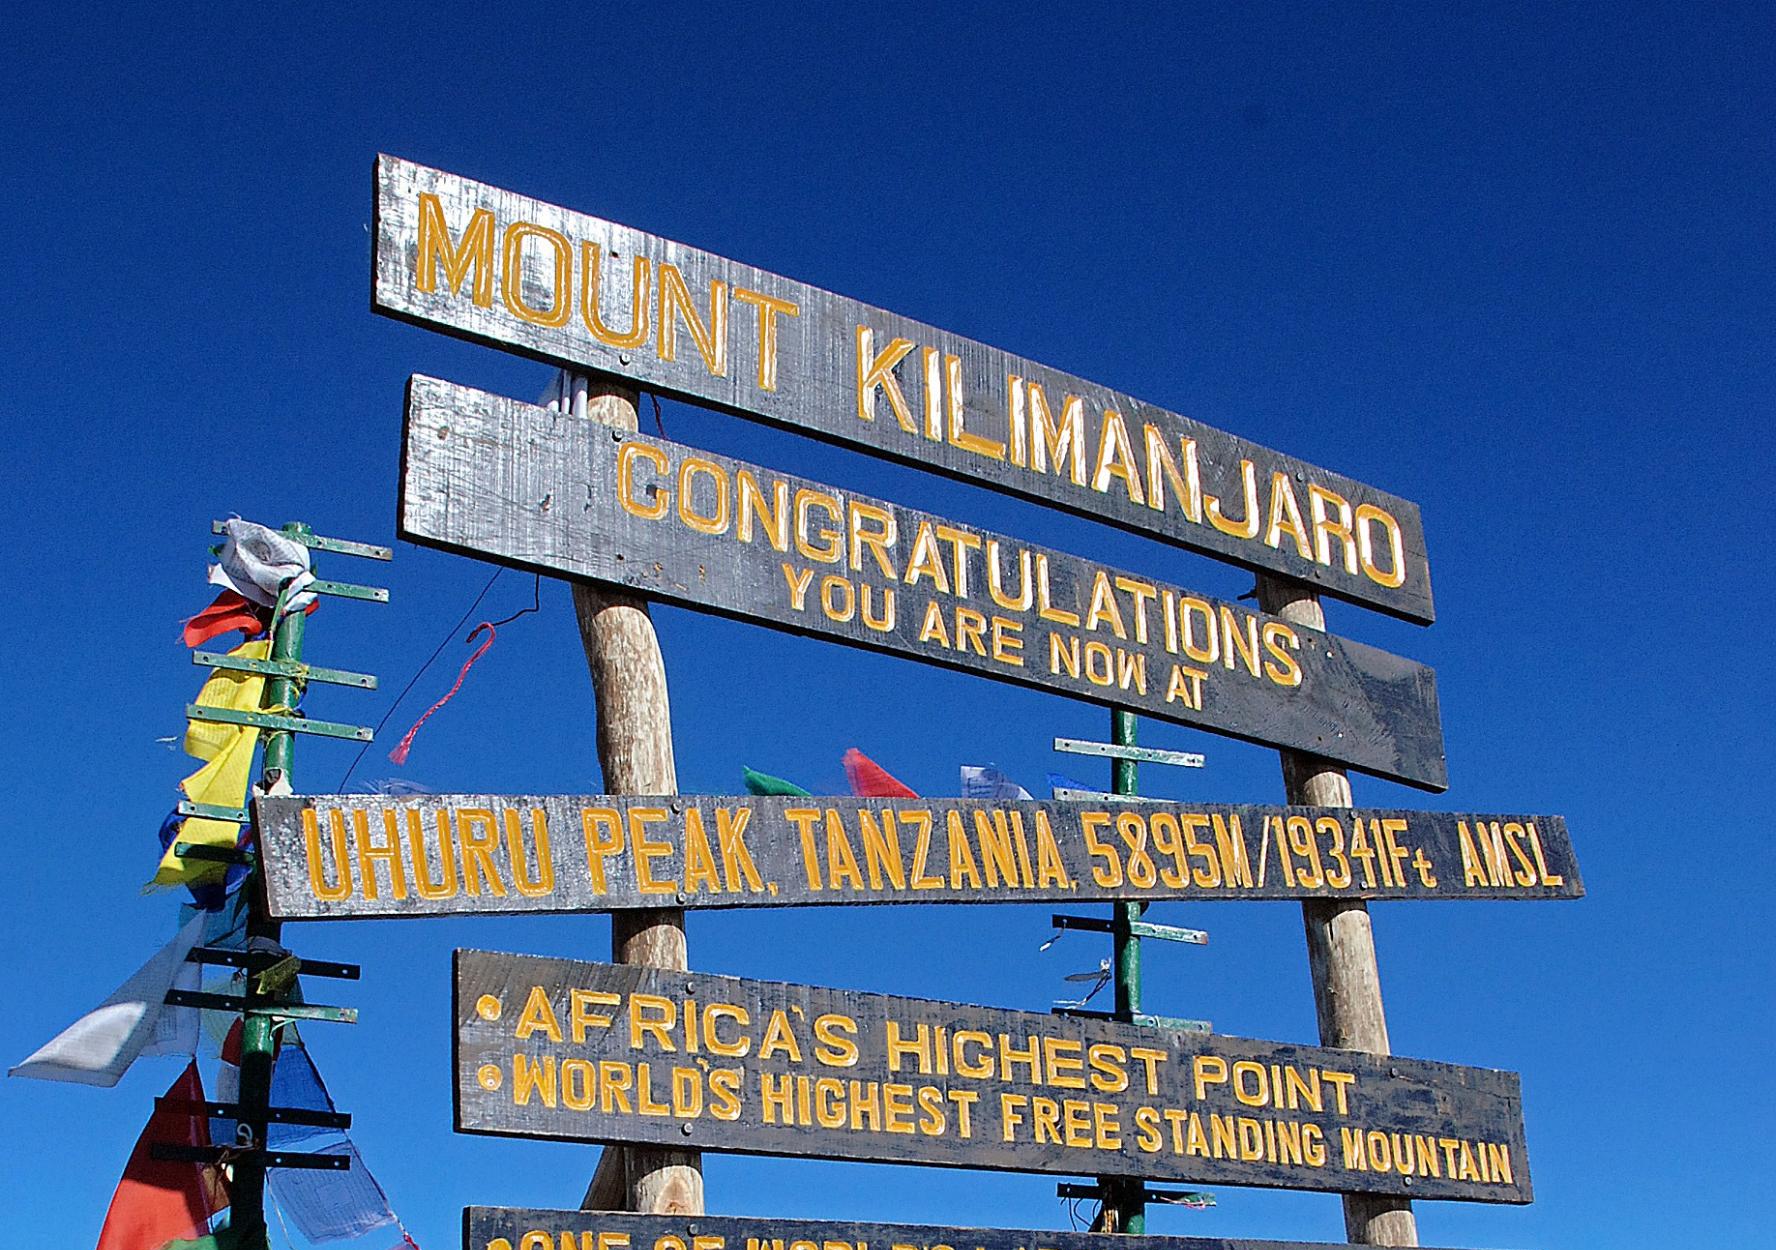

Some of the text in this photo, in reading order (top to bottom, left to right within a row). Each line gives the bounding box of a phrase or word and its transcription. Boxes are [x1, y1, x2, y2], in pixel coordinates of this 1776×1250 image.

[415, 191, 1407, 590] MOUNT KILIMANJARO
[616, 440, 1303, 686] CONGRATULATIONS
[781, 562, 1210, 711] YOU ARE NOW AT
[301, 806, 553, 900] UHURU
[581, 806, 780, 897] PEAK,
[1457, 819, 1564, 888] AMSL
[512, 1053, 1514, 1184] WORLD'S HIGHEST FREE STANDING MOUNTAIN
[514, 985, 1356, 1116] AFRICA'S HIGHEST POINT
